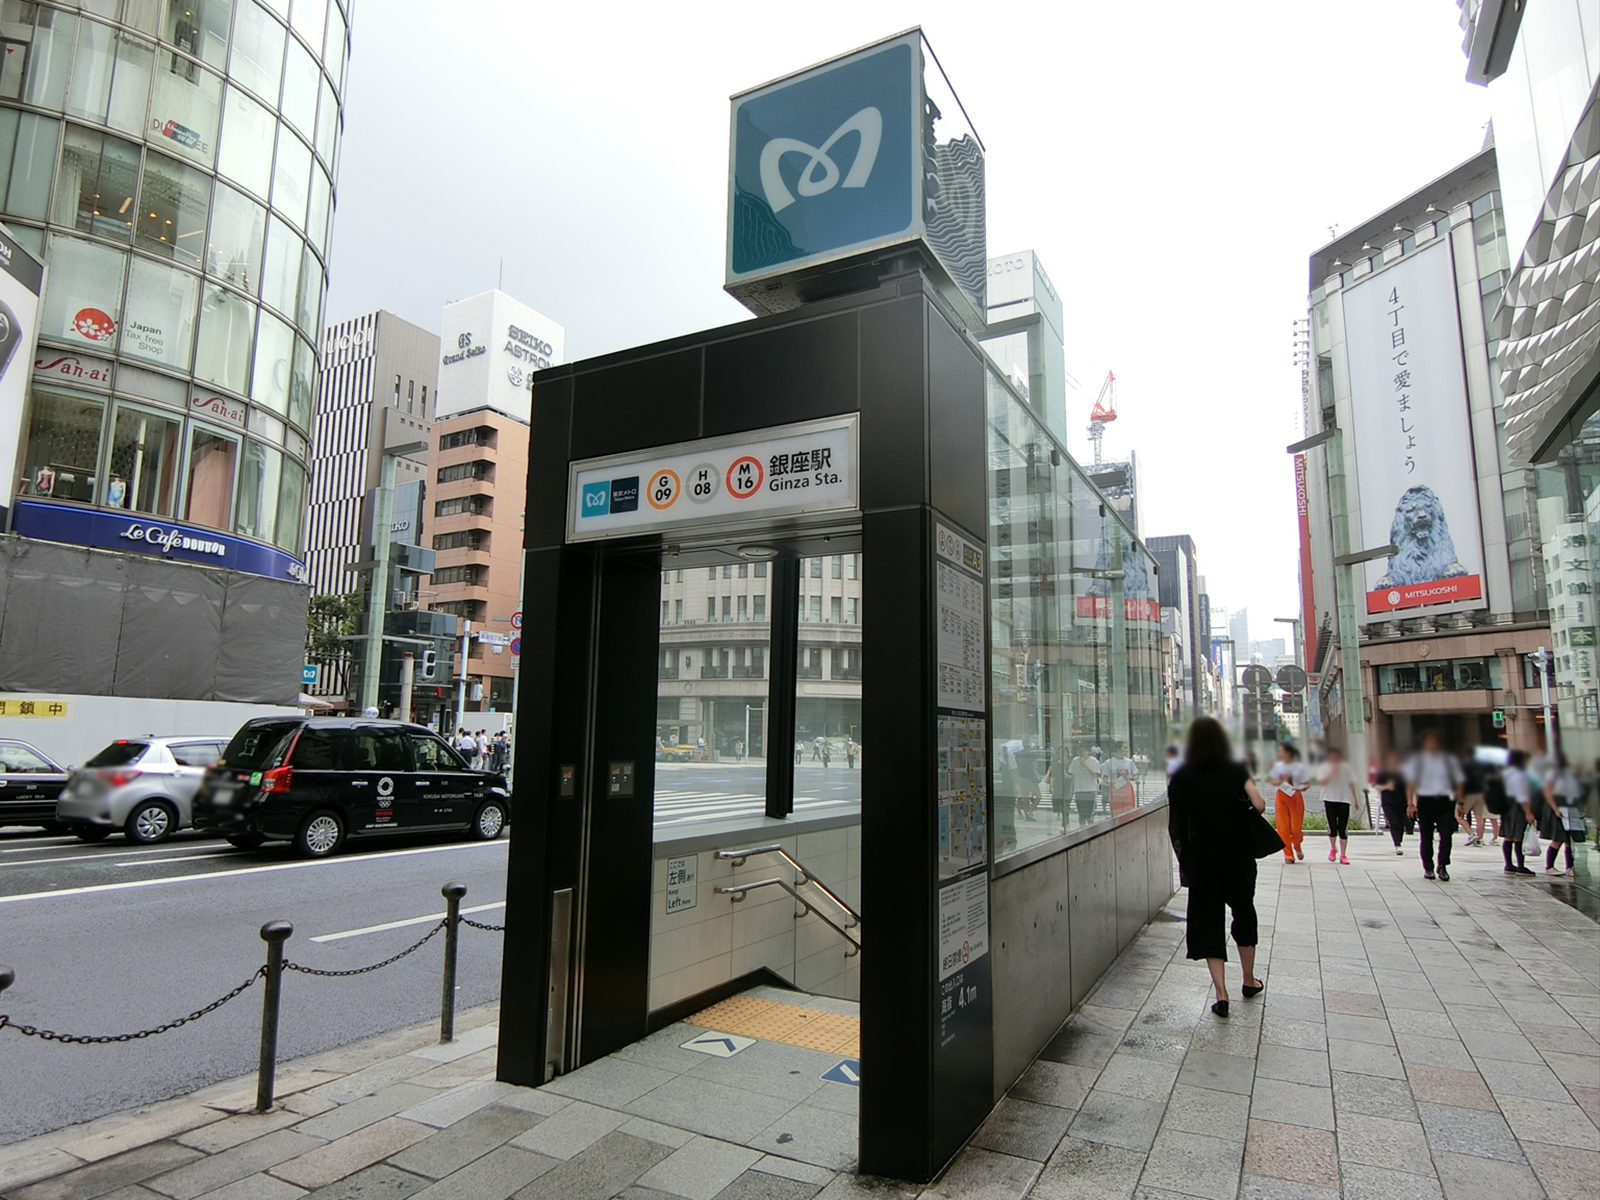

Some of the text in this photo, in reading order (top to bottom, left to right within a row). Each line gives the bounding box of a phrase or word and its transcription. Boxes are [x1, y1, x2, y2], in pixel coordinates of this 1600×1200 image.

[130, 321, 162, 335] Japan
[125, 328, 164, 346] Tax free
[508, 324, 553, 357] SEIKO
[138, 341, 163, 355] Shop
[442, 345, 487, 365] Grand Seiko
[34, 356, 110, 383] San-ai
[1387, 286, 1417, 475] 4丁目で愛ましょう
[193, 397, 245, 423] San-ai
[739, 464, 751, 476] M
[769, 448, 832, 477] 銀座駅
[659, 476, 669, 487] G
[698, 470, 708, 481] H
[737, 476, 754, 490] 16
[769, 471, 843, 492] Ginza Sta.
[655, 488, 672, 501] 09
[694, 482, 711, 496] 08
[1295, 457, 1307, 516] MITSUKOSHI
[120, 523, 226, 556] Le Café DOUTOR
[1404, 584, 1458, 599] MITSUKOSHI
[669, 860, 686, 869] ここでは
[668, 897, 681, 909] Left
[958, 985, 978, 1009] 4.1m
